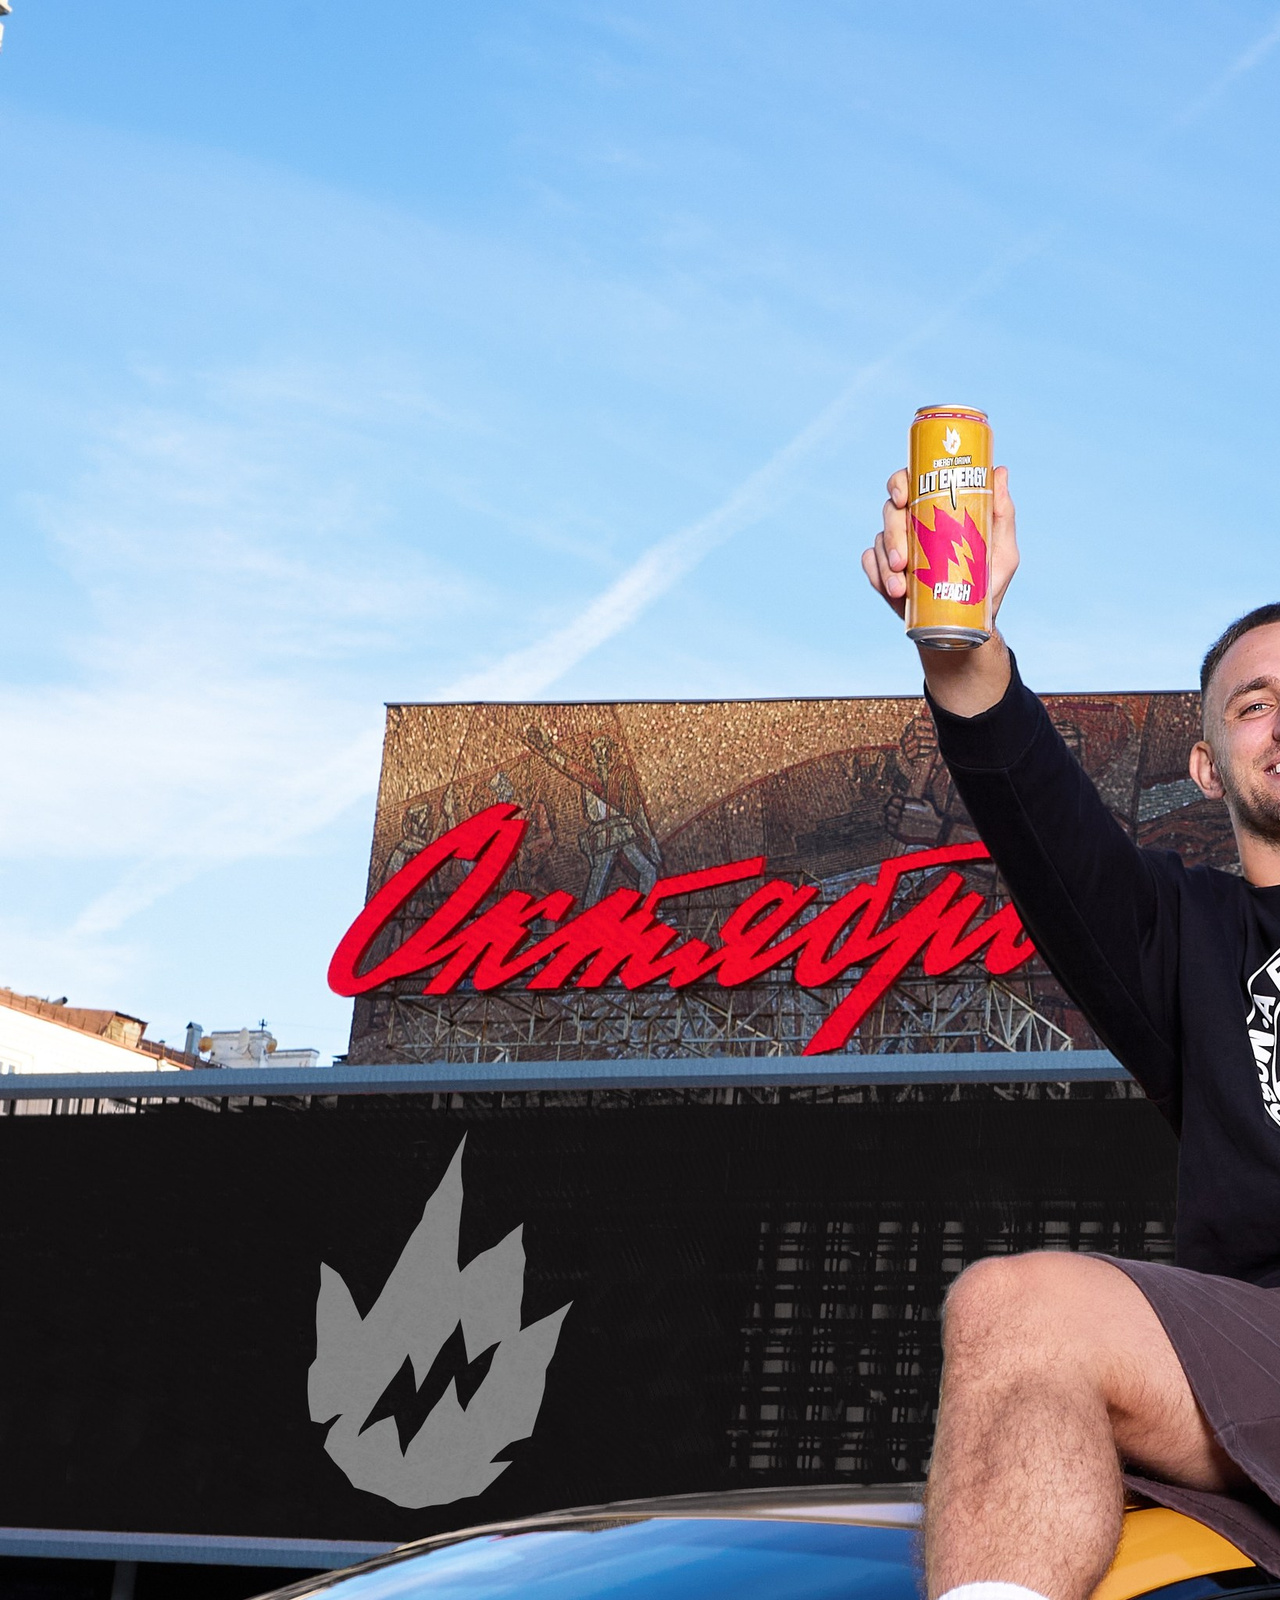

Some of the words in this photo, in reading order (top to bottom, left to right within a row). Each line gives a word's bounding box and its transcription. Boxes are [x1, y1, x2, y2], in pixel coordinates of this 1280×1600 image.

[918, 470, 939, 496] LIT
[938, 466, 988, 510] ENERGY
[932, 582, 972, 602] PEACH
